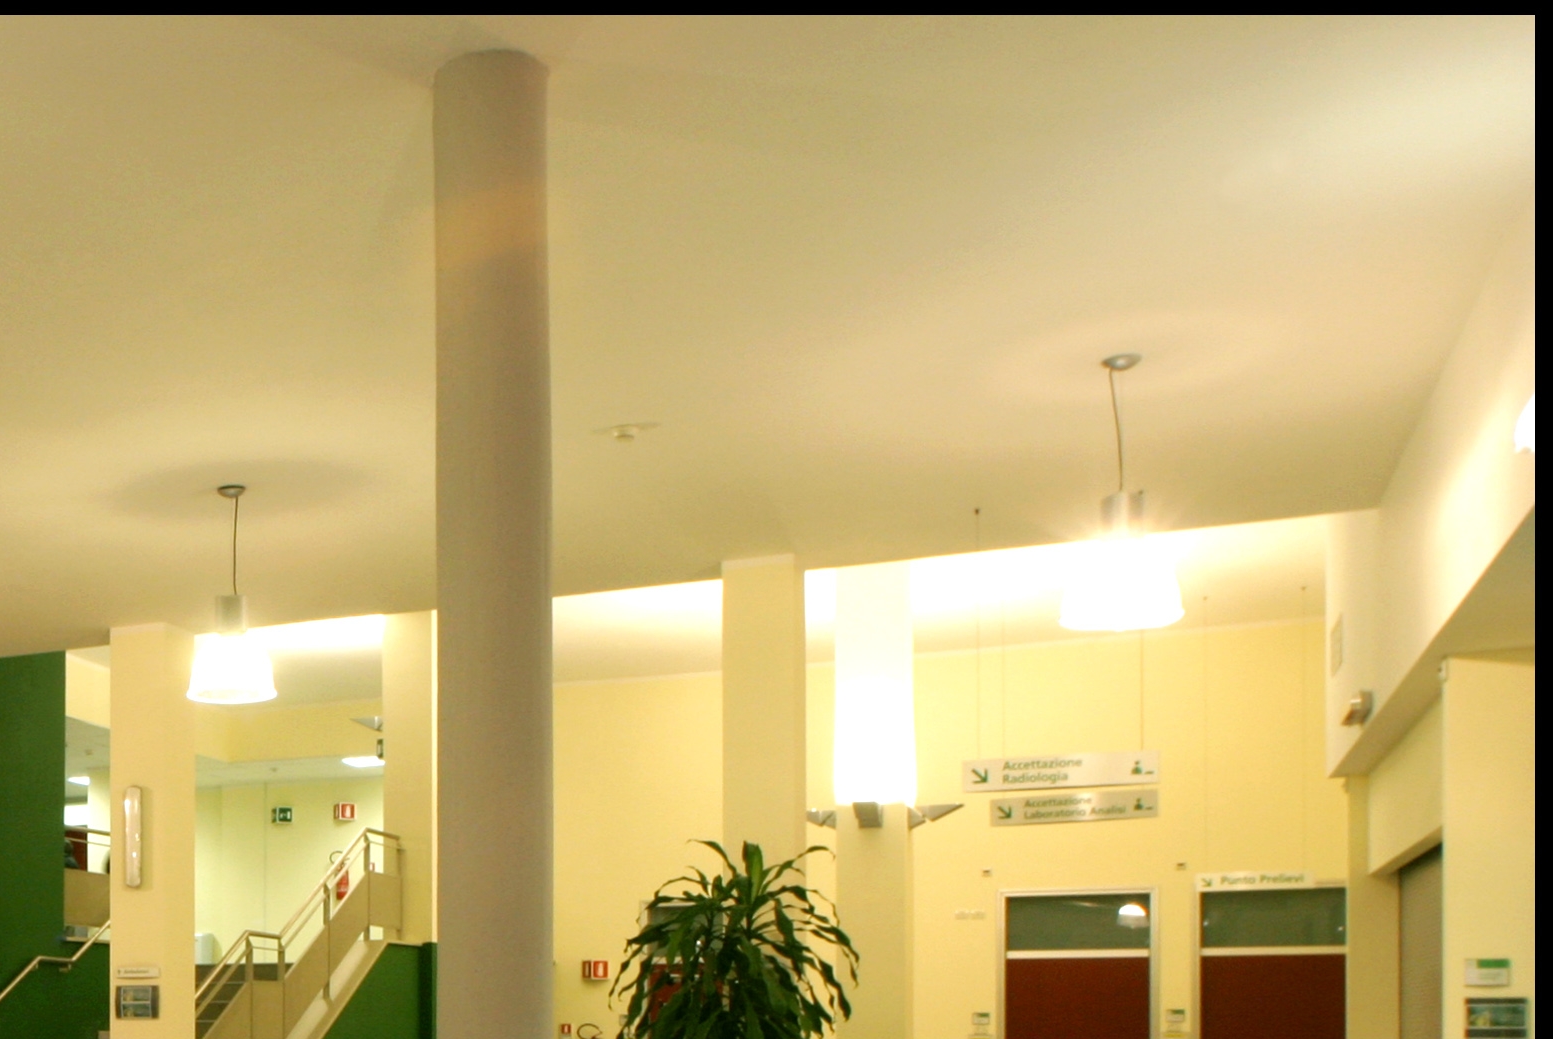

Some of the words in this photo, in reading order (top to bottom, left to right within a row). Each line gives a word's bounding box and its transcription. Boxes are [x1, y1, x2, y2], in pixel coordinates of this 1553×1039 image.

[1002, 758, 1083, 771] Accettazione
[1002, 771, 1069, 784] Radiologia
[1024, 796, 1092, 808] Accettazione
[1024, 807, 1086, 820] Laboratorio
[1090, 805, 1127, 816] Analisi
[1220, 876, 1256, 885] Punto
[1259, 873, 1305, 884] Prelievi
